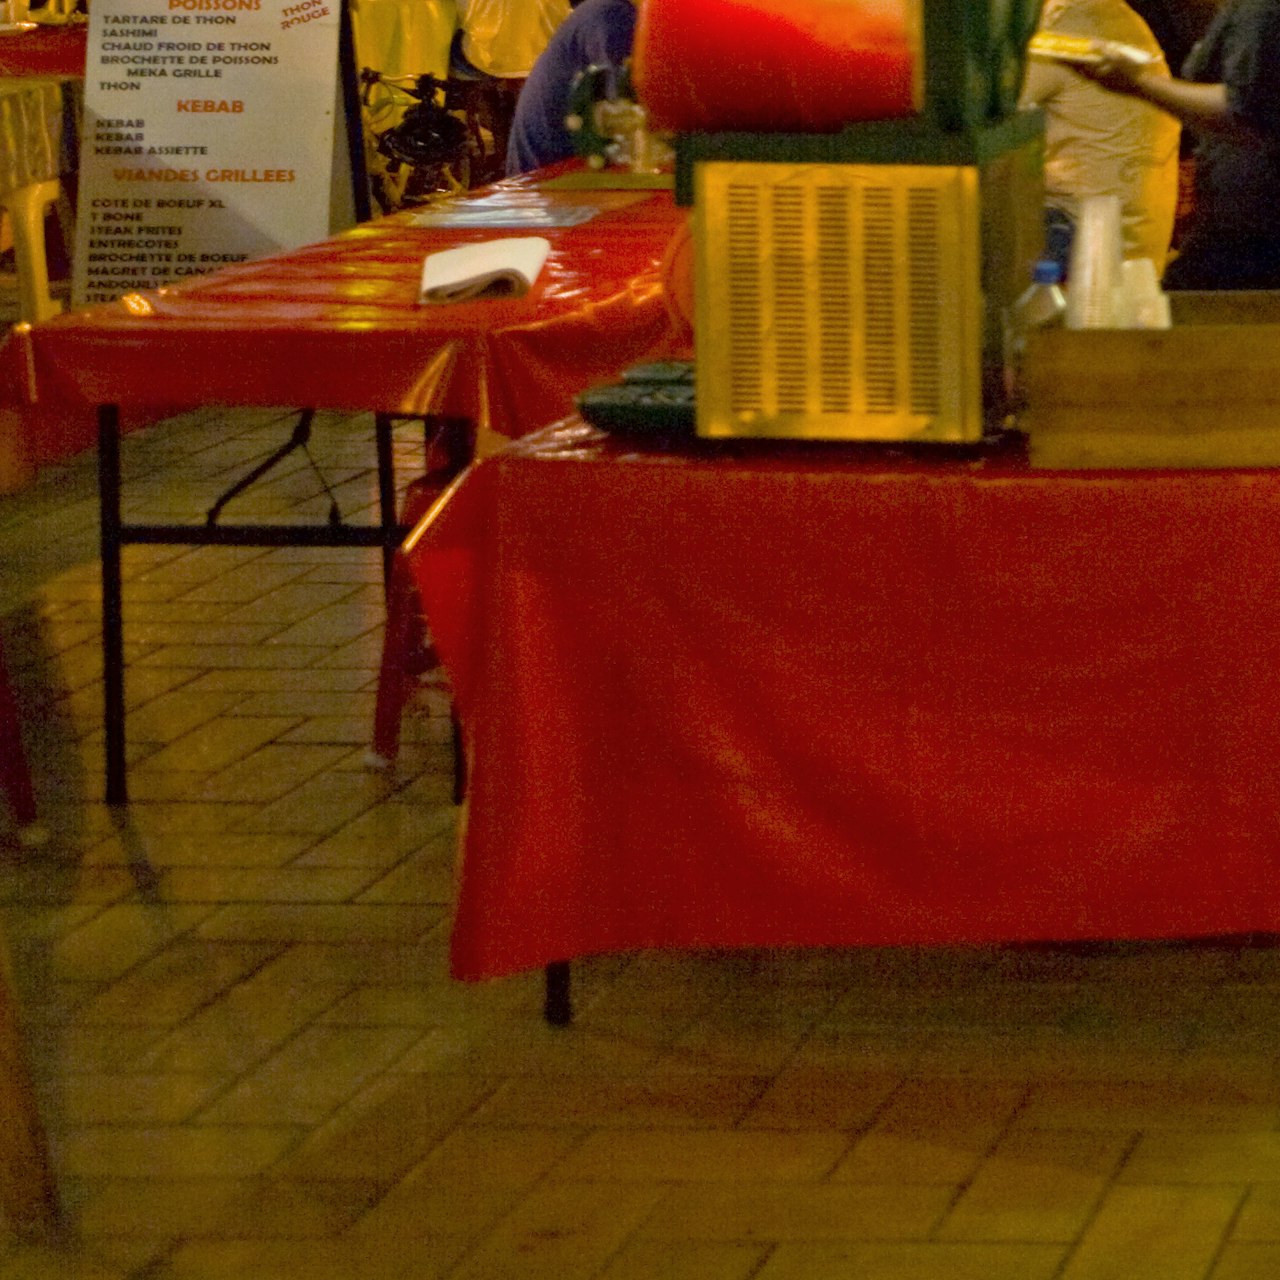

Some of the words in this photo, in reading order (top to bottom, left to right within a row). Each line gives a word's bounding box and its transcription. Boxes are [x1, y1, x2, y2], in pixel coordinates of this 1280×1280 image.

[103, 15, 168, 25] TARTARE
[171, 15, 191, 25] DE
[195, 15, 236, 25] THON
[280, 6, 330, 30] ROUGE
[102, 28, 158, 38] SASHIMI
[101, 42, 153, 52] CHAUD
[157, 42, 202, 52] FROID
[206, 43, 225, 52] DE
[230, 43, 271, 52] THON
[101, 55, 185, 65] BROCHETTE
[189, 56, 208, 65] DE
[212, 56, 279, 65] POISSONS
[172, 69, 222, 78] GRILLE
[99, 81, 141, 91] THON
[176, 99, 244, 113] KEBAB
[96, 119, 145, 129] KEBAB
[95, 132, 144, 142] KEBAB
[94, 146, 143, 156] KEBAB
[147, 146, 208, 156] ASSIETTE
[114, 168, 199, 182] VIANDES
[205, 169, 296, 183] GRILLEES
[133, 199, 151, 208] DE
[156, 199, 205, 209] BOEUF
[208, 200, 226, 209] XL
[177, 254, 196, 263] DE
[200, 253, 249, 263] BOEUF
[151, 267, 170, 276] DE
